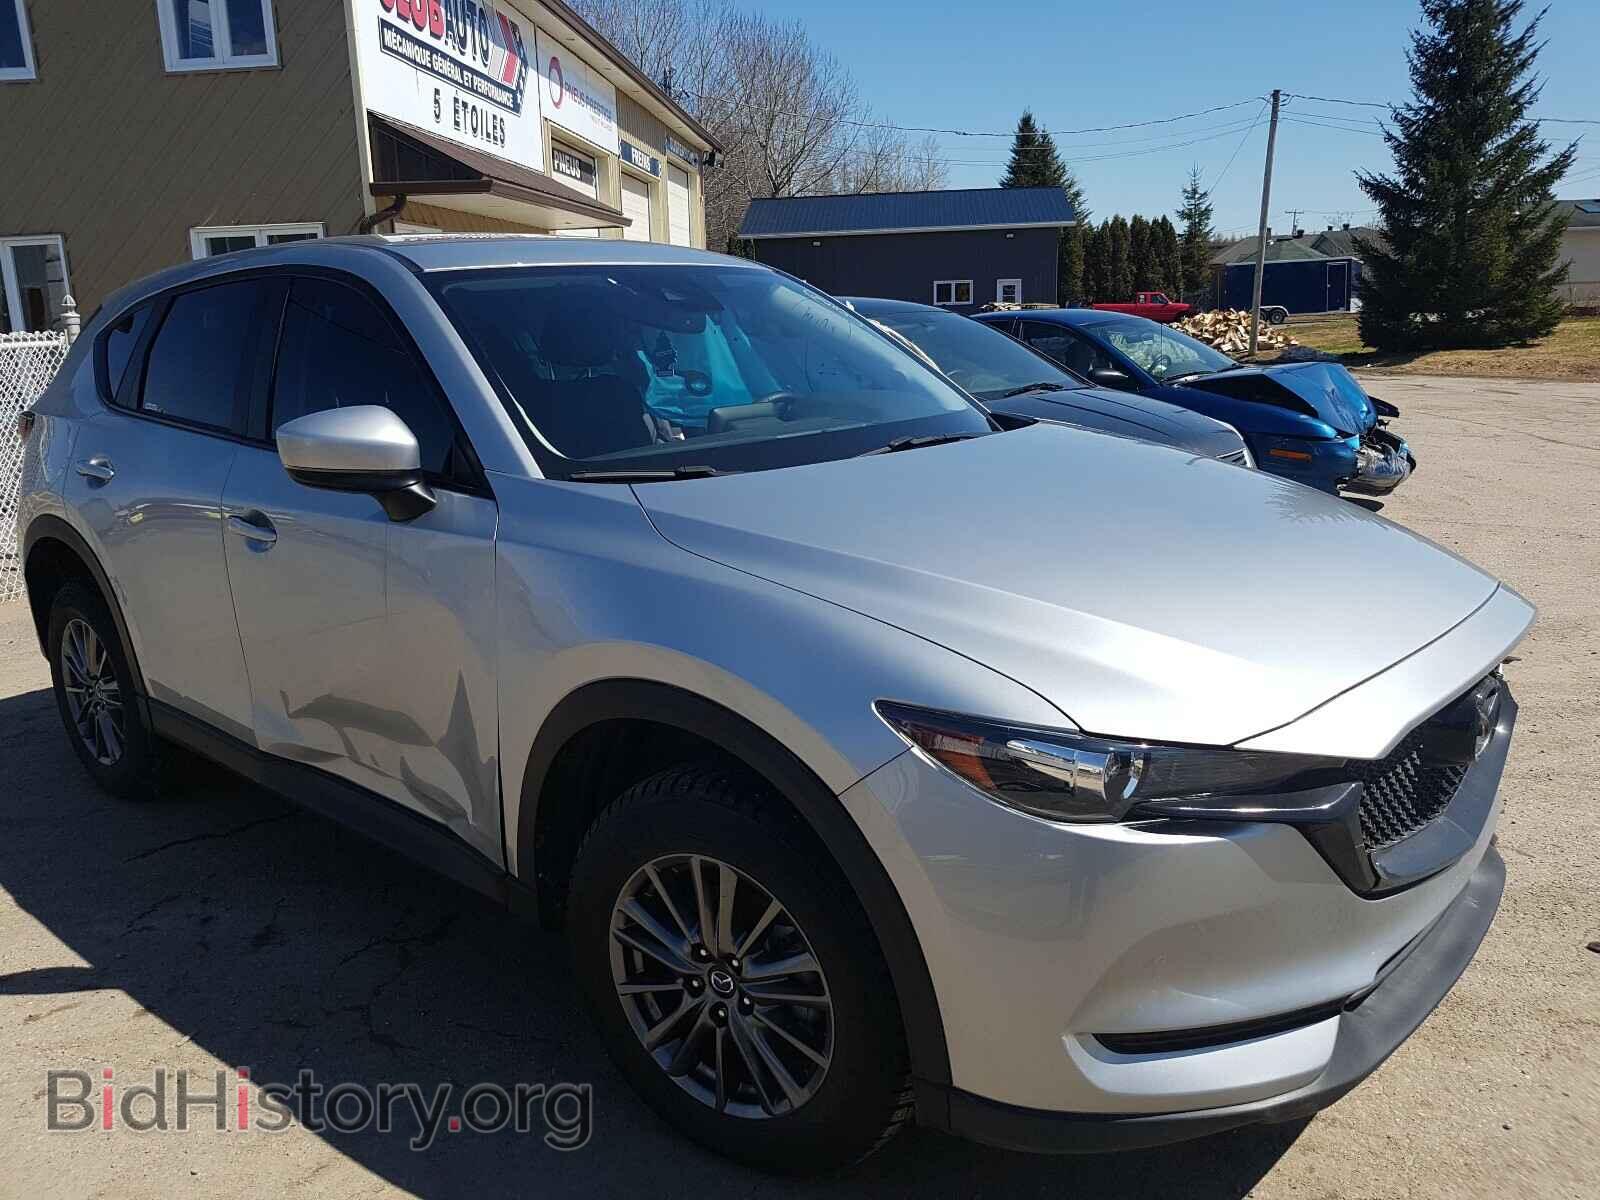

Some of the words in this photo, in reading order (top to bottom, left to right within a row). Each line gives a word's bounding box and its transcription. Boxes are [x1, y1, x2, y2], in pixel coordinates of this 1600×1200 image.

[383, 27, 432, 69] MÉCANIQUE
[431, 52, 463, 84] GÉNÉRAL
[462, 70, 472, 88] ET
[433, 87, 441, 123] 5
[453, 89, 506, 148] ÉTOILES
[553, 149, 580, 179] PNEUS
[631, 147, 651, 172] FREINS
